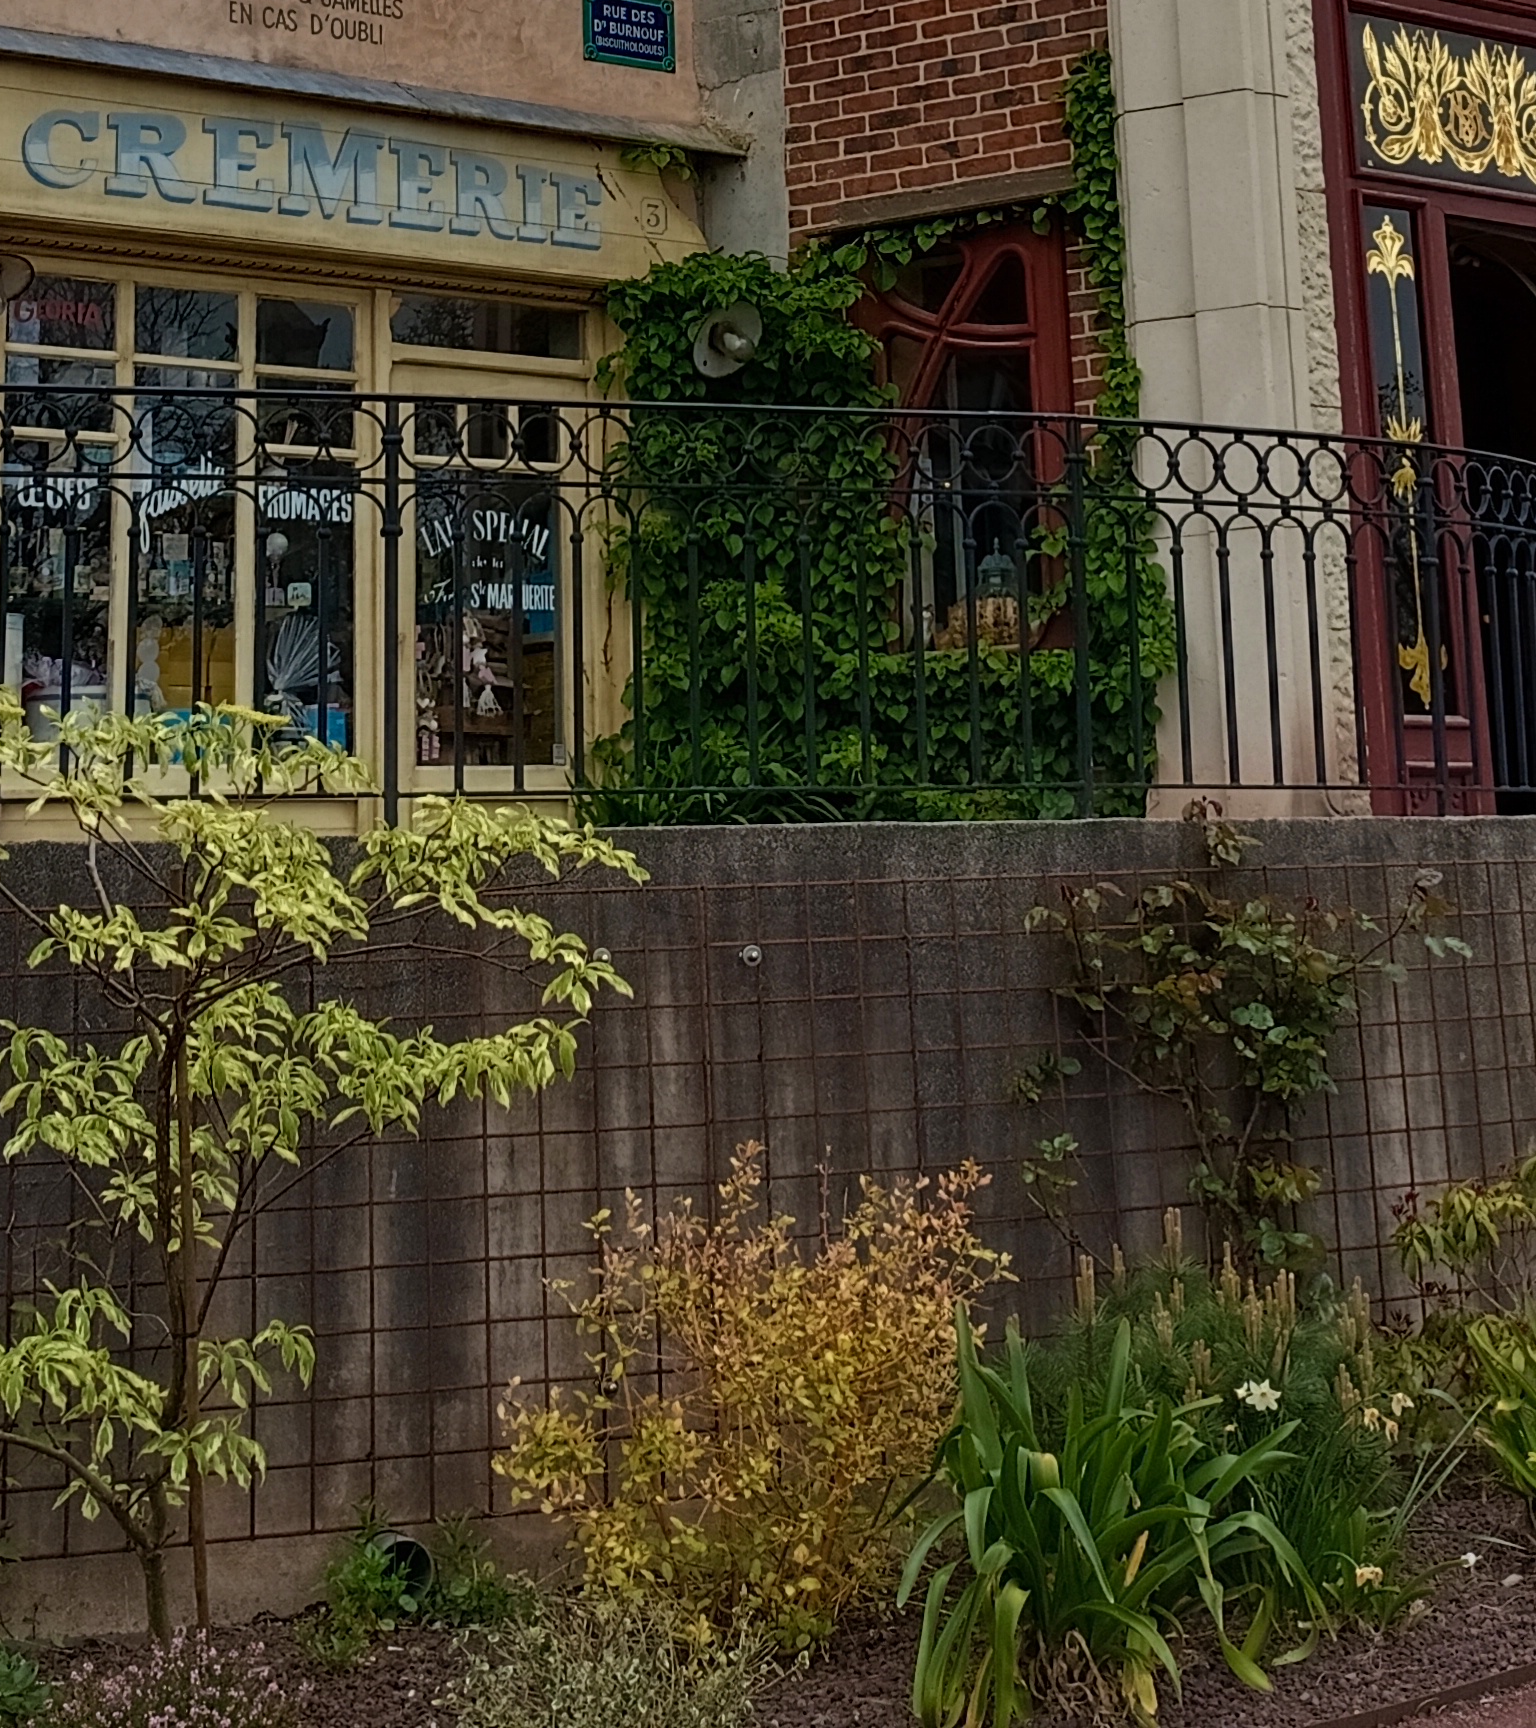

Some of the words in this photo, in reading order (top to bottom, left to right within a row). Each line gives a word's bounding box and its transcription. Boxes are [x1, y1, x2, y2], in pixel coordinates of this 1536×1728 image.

[229, 0, 253, 26] EN
[261, 6, 299, 33] CAS
[310, 12, 384, 46] D'OUBLI
[603, 4, 628, 20] RUE
[631, 9, 656, 25] DES
[609, 21, 665, 43] BURNOUF
[21, 108, 602, 252] CREMERIE
[646, 203, 661, 228] 3
[419, 513, 454, 558] LAI
[487, 582, 556, 612] MARUERITE
